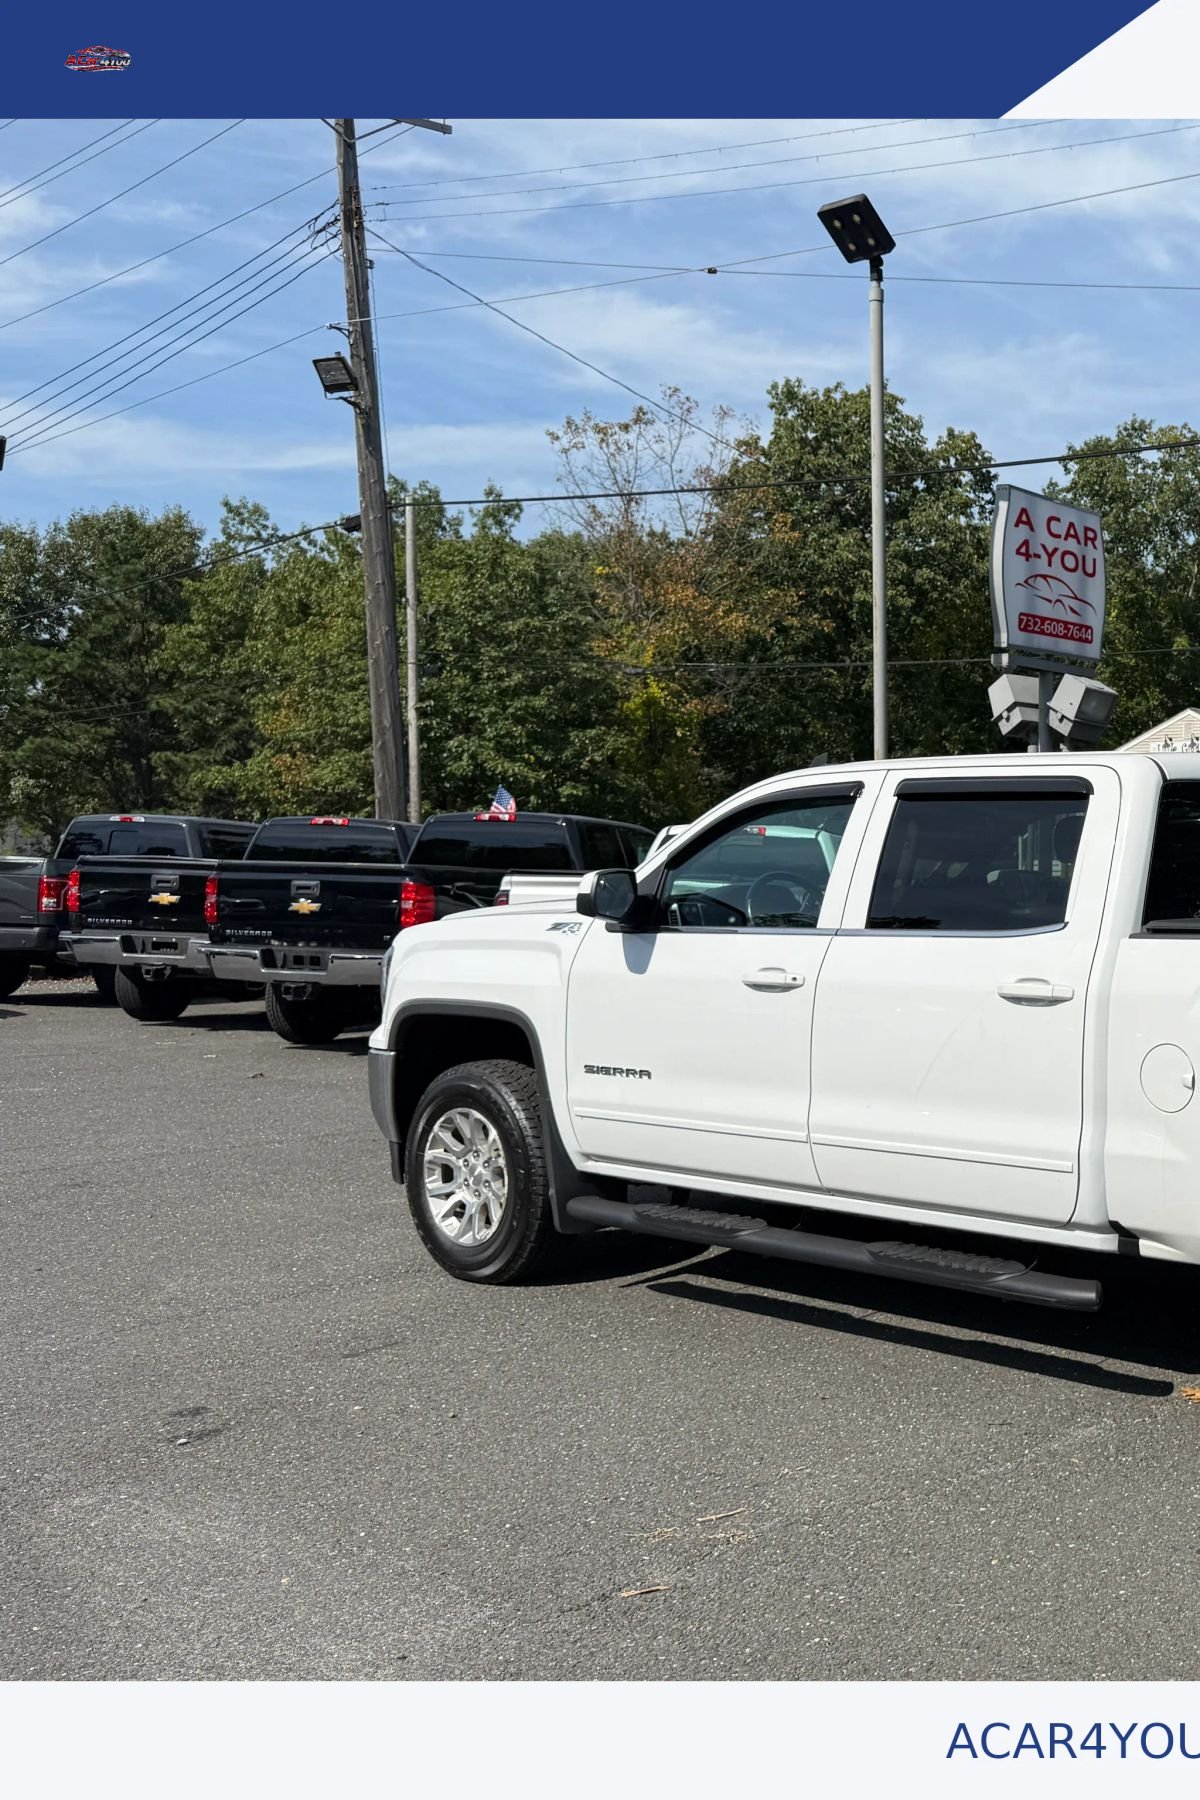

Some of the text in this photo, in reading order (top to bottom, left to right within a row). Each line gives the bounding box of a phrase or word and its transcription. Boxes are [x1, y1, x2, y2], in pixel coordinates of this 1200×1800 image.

[1014, 507, 1098, 550] A CAR
[1016, 539, 1097, 578] 4-YOU
[1019, 615, 1093, 642] 732-608-7644
[225, 929, 273, 937] SILVERADO
[583, 1064, 652, 1080] SIERRA
